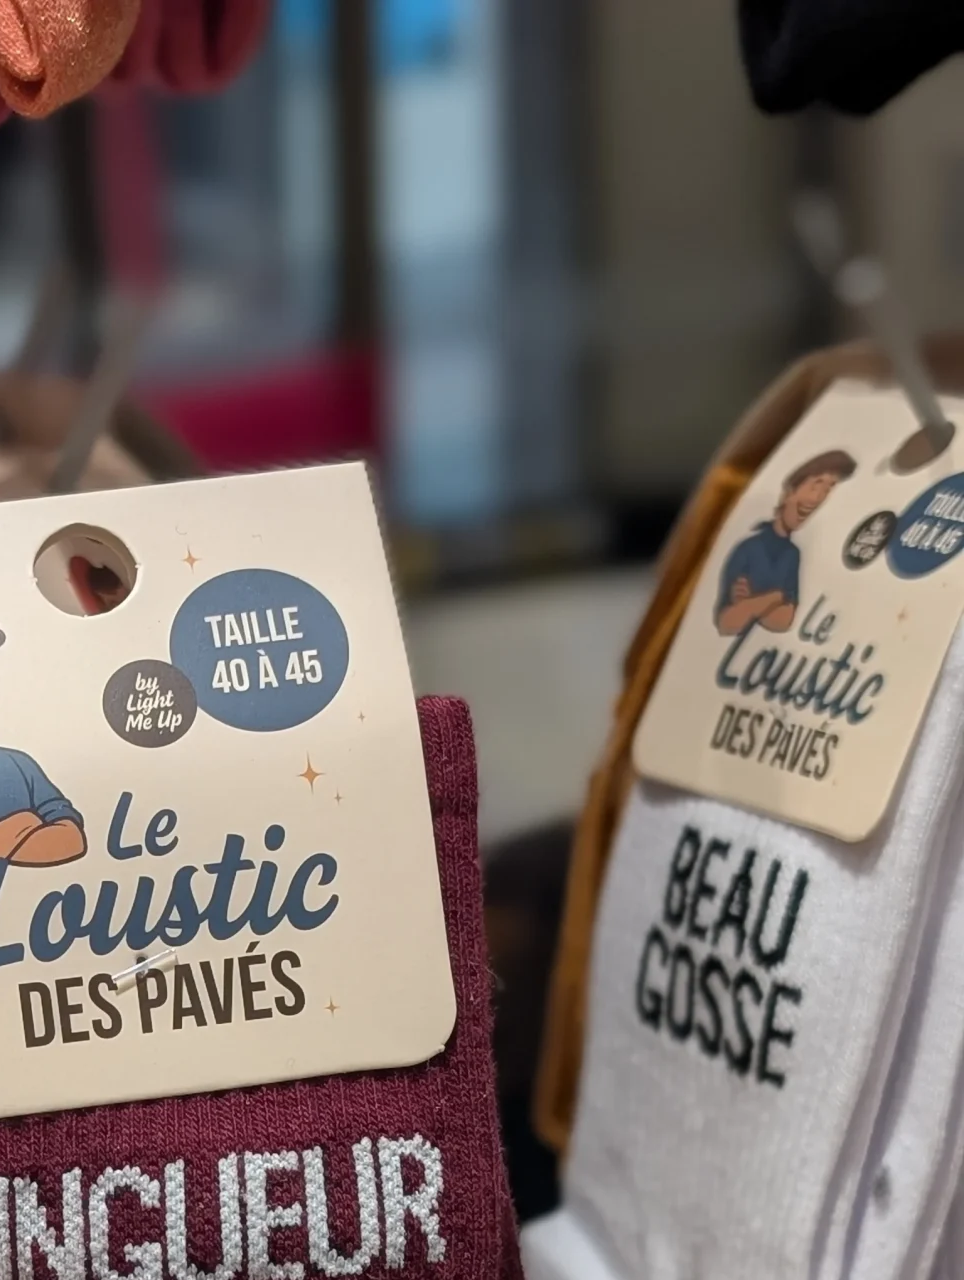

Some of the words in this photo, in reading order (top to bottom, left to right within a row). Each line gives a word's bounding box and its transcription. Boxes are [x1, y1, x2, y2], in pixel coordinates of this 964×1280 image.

[204, 606, 303, 649] TAILLE
[798, 593, 837, 646] Le
[135, 672, 160, 696] by
[211, 657, 251, 694] 40
[257, 648, 279, 690] À
[285, 649, 323, 686] 45
[715, 615, 884, 726] Loustic
[125, 712, 153, 733] Me
[157, 709, 183, 733] Up
[126, 690, 175, 716] Light
[710, 704, 764, 760] DES
[757, 717, 840, 781] PAVÉS
[107, 791, 179, 861] Le
[663, 823, 809, 970] BEAU
[18, 972, 123, 1049] DES
[135, 940, 306, 1034] PAVÉS
[636, 922, 804, 1090] GOSSE
